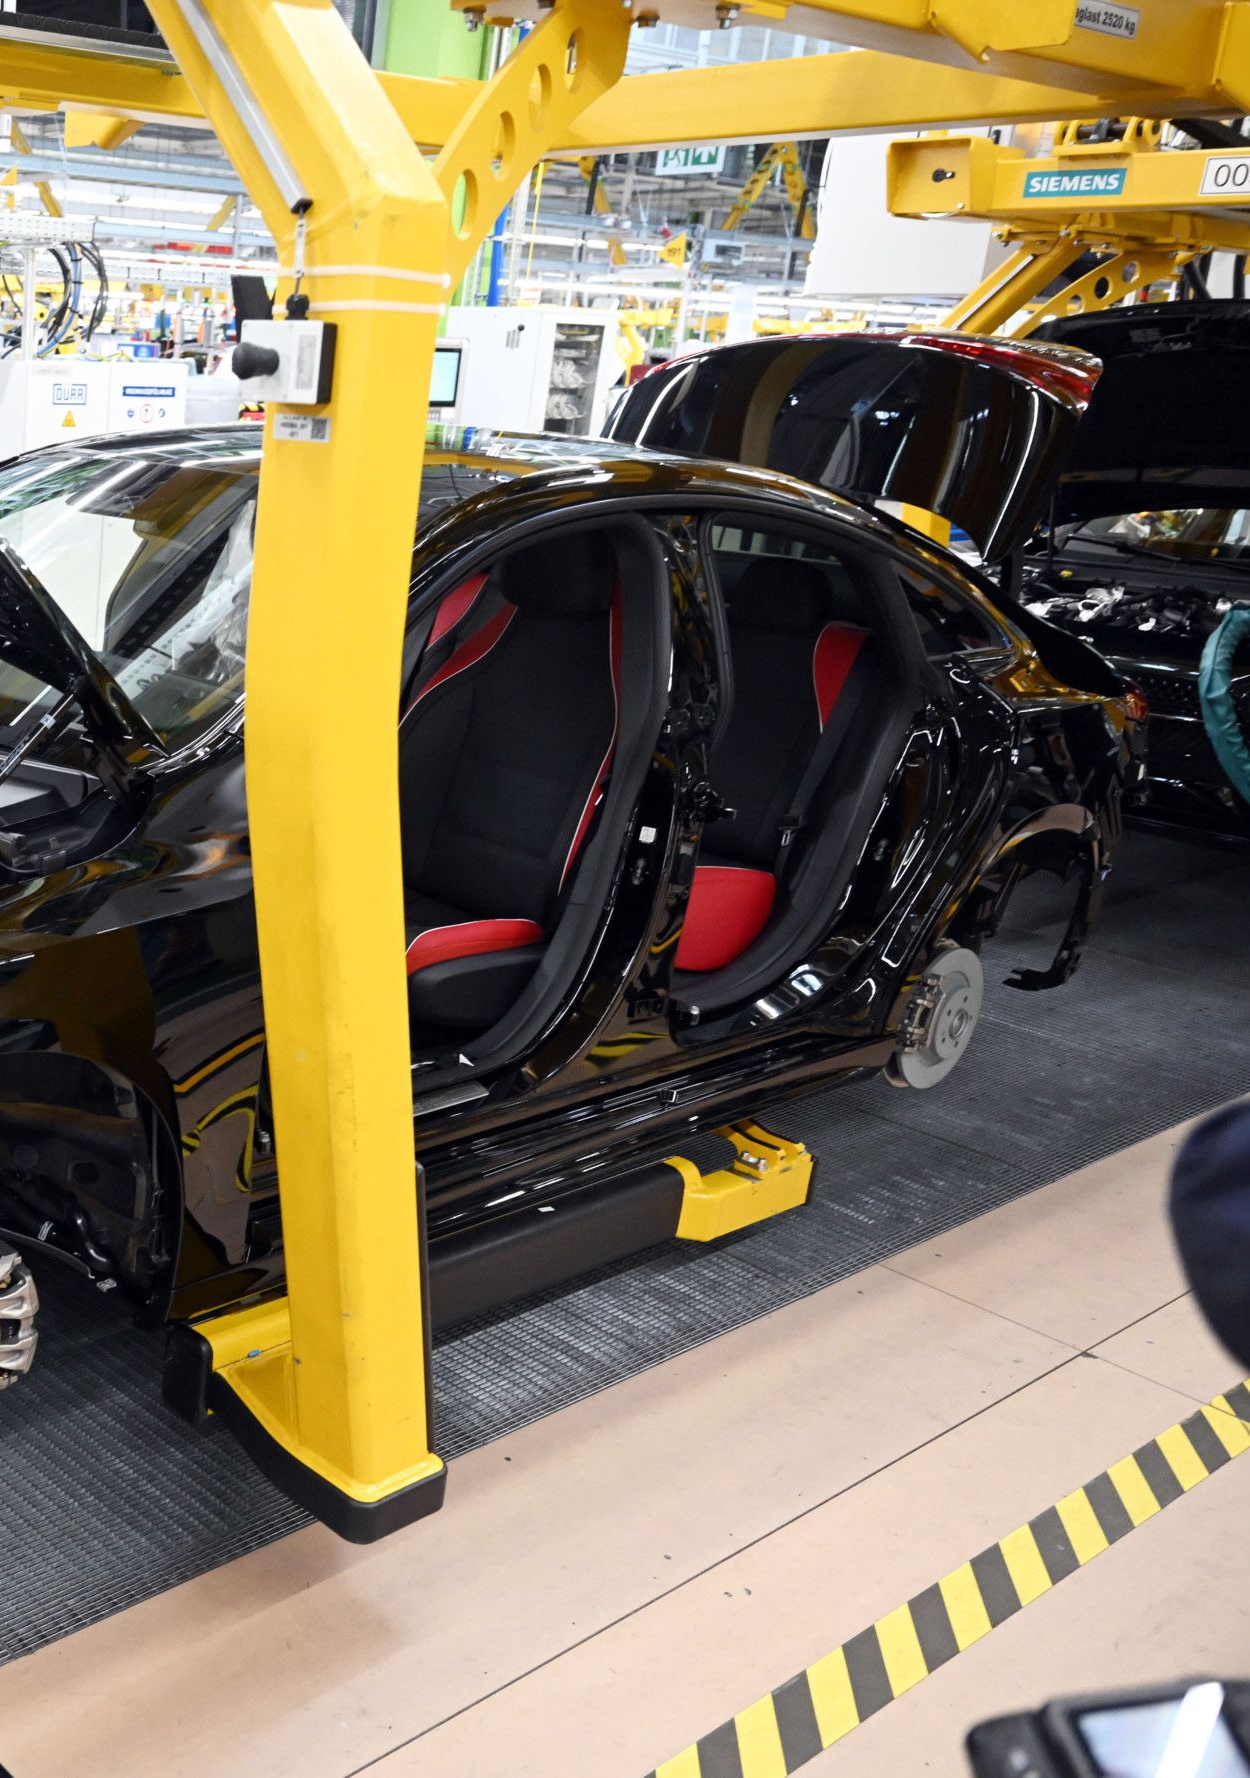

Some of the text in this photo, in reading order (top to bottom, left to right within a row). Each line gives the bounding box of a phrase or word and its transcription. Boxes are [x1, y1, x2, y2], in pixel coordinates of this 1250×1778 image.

[1102, 11, 1124, 29] 2520
[1125, 17, 1136, 35] kg
[1029, 174, 1120, 193] SIEMENS
[1214, 163, 1250, 187] 00
[667, 247, 681, 257] 191
